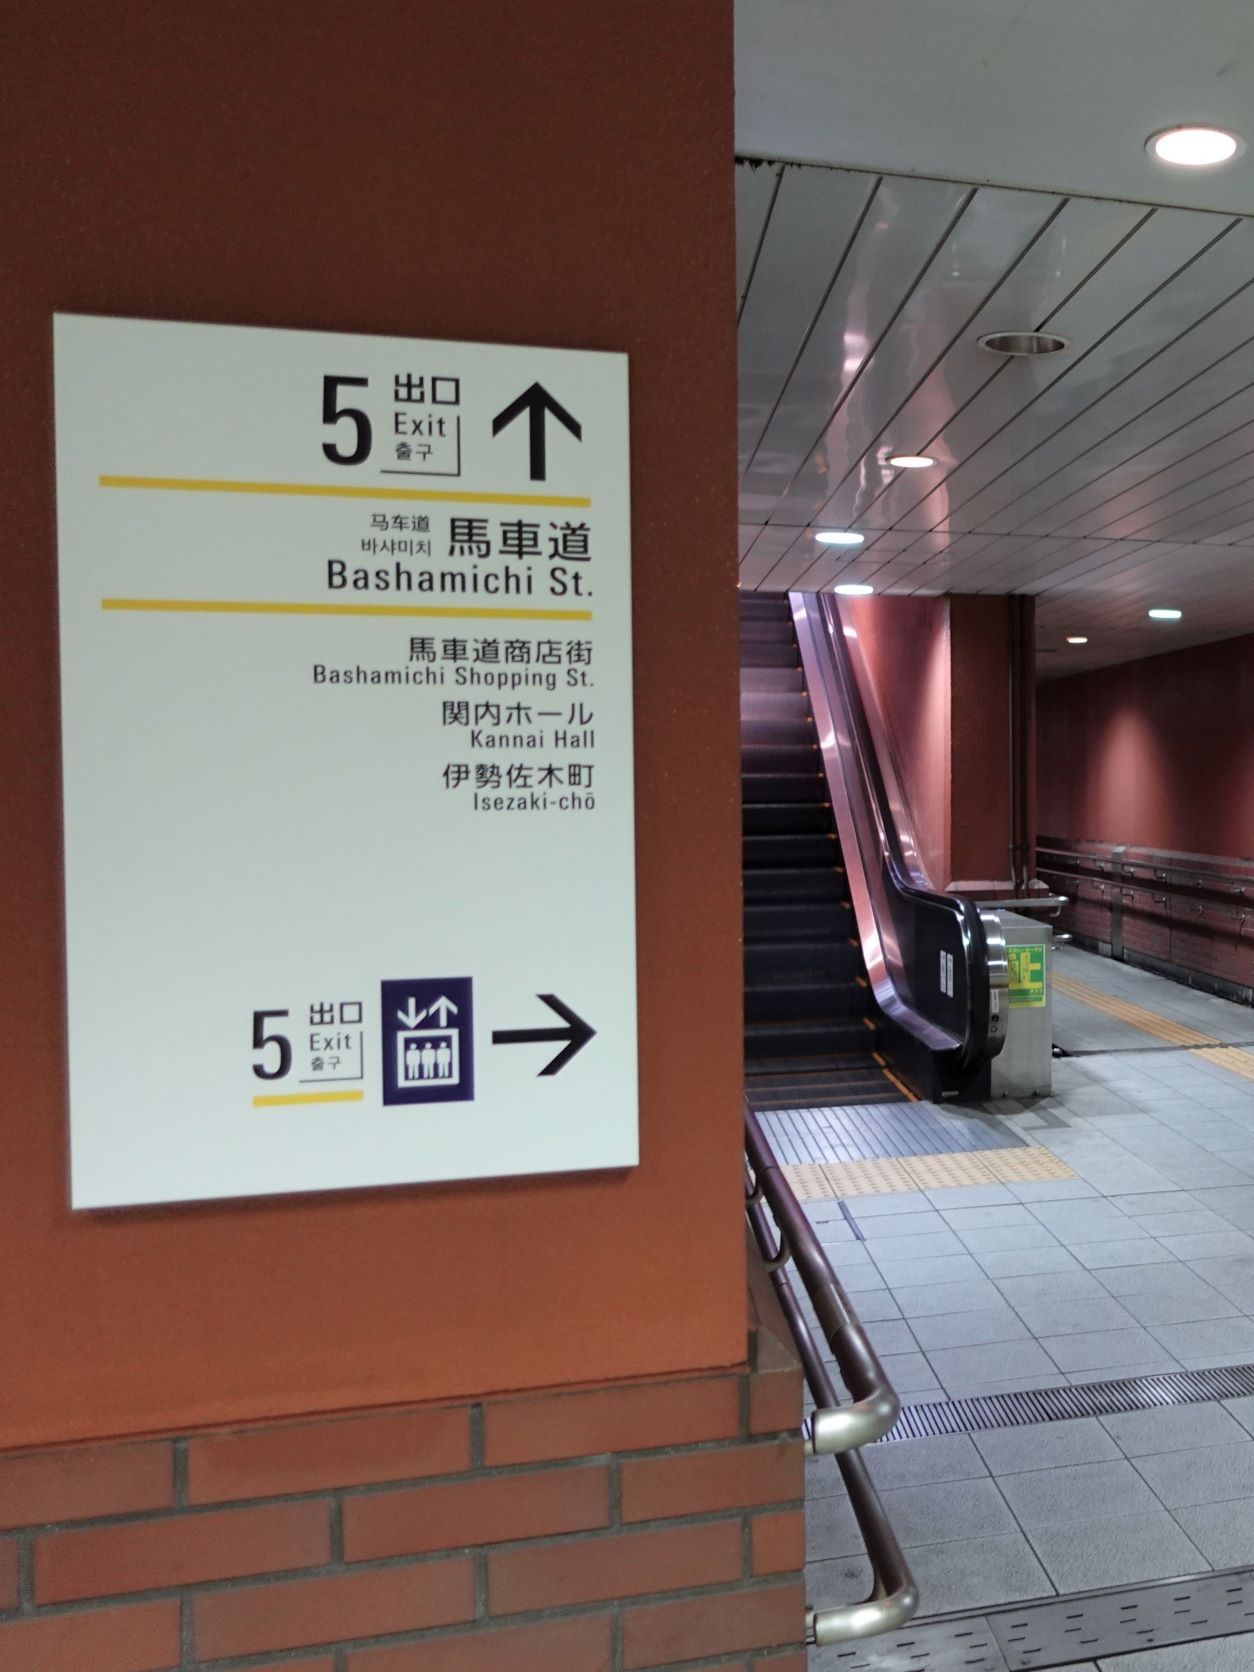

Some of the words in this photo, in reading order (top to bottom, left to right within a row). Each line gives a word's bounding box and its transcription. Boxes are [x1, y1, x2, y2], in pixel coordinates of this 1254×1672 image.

[393, 373, 460, 405] 出口
[321, 374, 373, 466] 5
[394, 412, 446, 437] Exit
[395, 442, 434, 462] 출구
[370, 513, 431, 532] 马车道
[361, 538, 432, 556] 바샤미치
[448, 517, 592, 561] 馬車道
[327, 560, 533, 595] Bashamichi
[549, 567, 593, 597] St.
[409, 637, 593, 666] 馬車道商店街
[313, 664, 445, 685] Bashamichi
[455, 667, 557, 690] Shopping
[566, 668, 595, 687] St.
[442, 700, 594, 726] 関内ホール
[471, 730, 544, 748] Kannai
[554, 730, 595, 748] Hall
[442, 763, 595, 789] 伊勢佐木町
[473, 792, 596, 811] Isezaki-chō
[309, 1001, 363, 1026] 出口
[252, 1009, 293, 1080] 5
[310, 1032, 352, 1052] Exit
[311, 1056, 342, 1072] 출구
